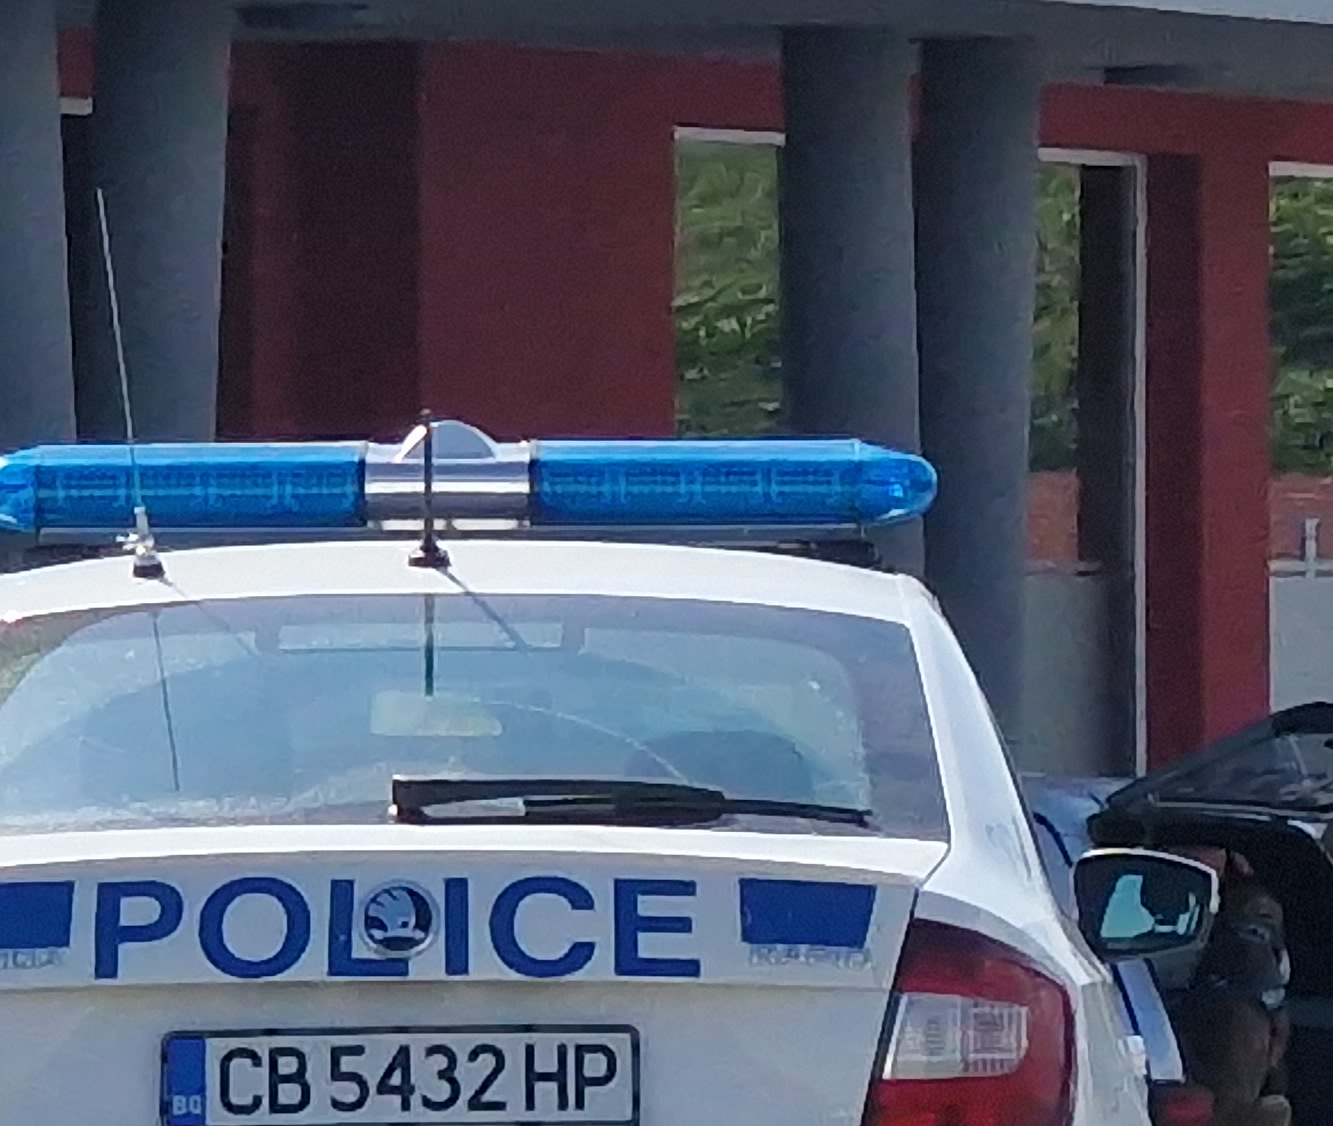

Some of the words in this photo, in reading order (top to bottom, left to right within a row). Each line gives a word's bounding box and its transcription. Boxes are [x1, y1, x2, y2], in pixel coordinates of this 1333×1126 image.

[94, 876, 701, 980] POLICE
[219, 1046, 311, 1115] CB
[330, 1044, 507, 1113] 5432
[524, 1043, 617, 1112] HP
